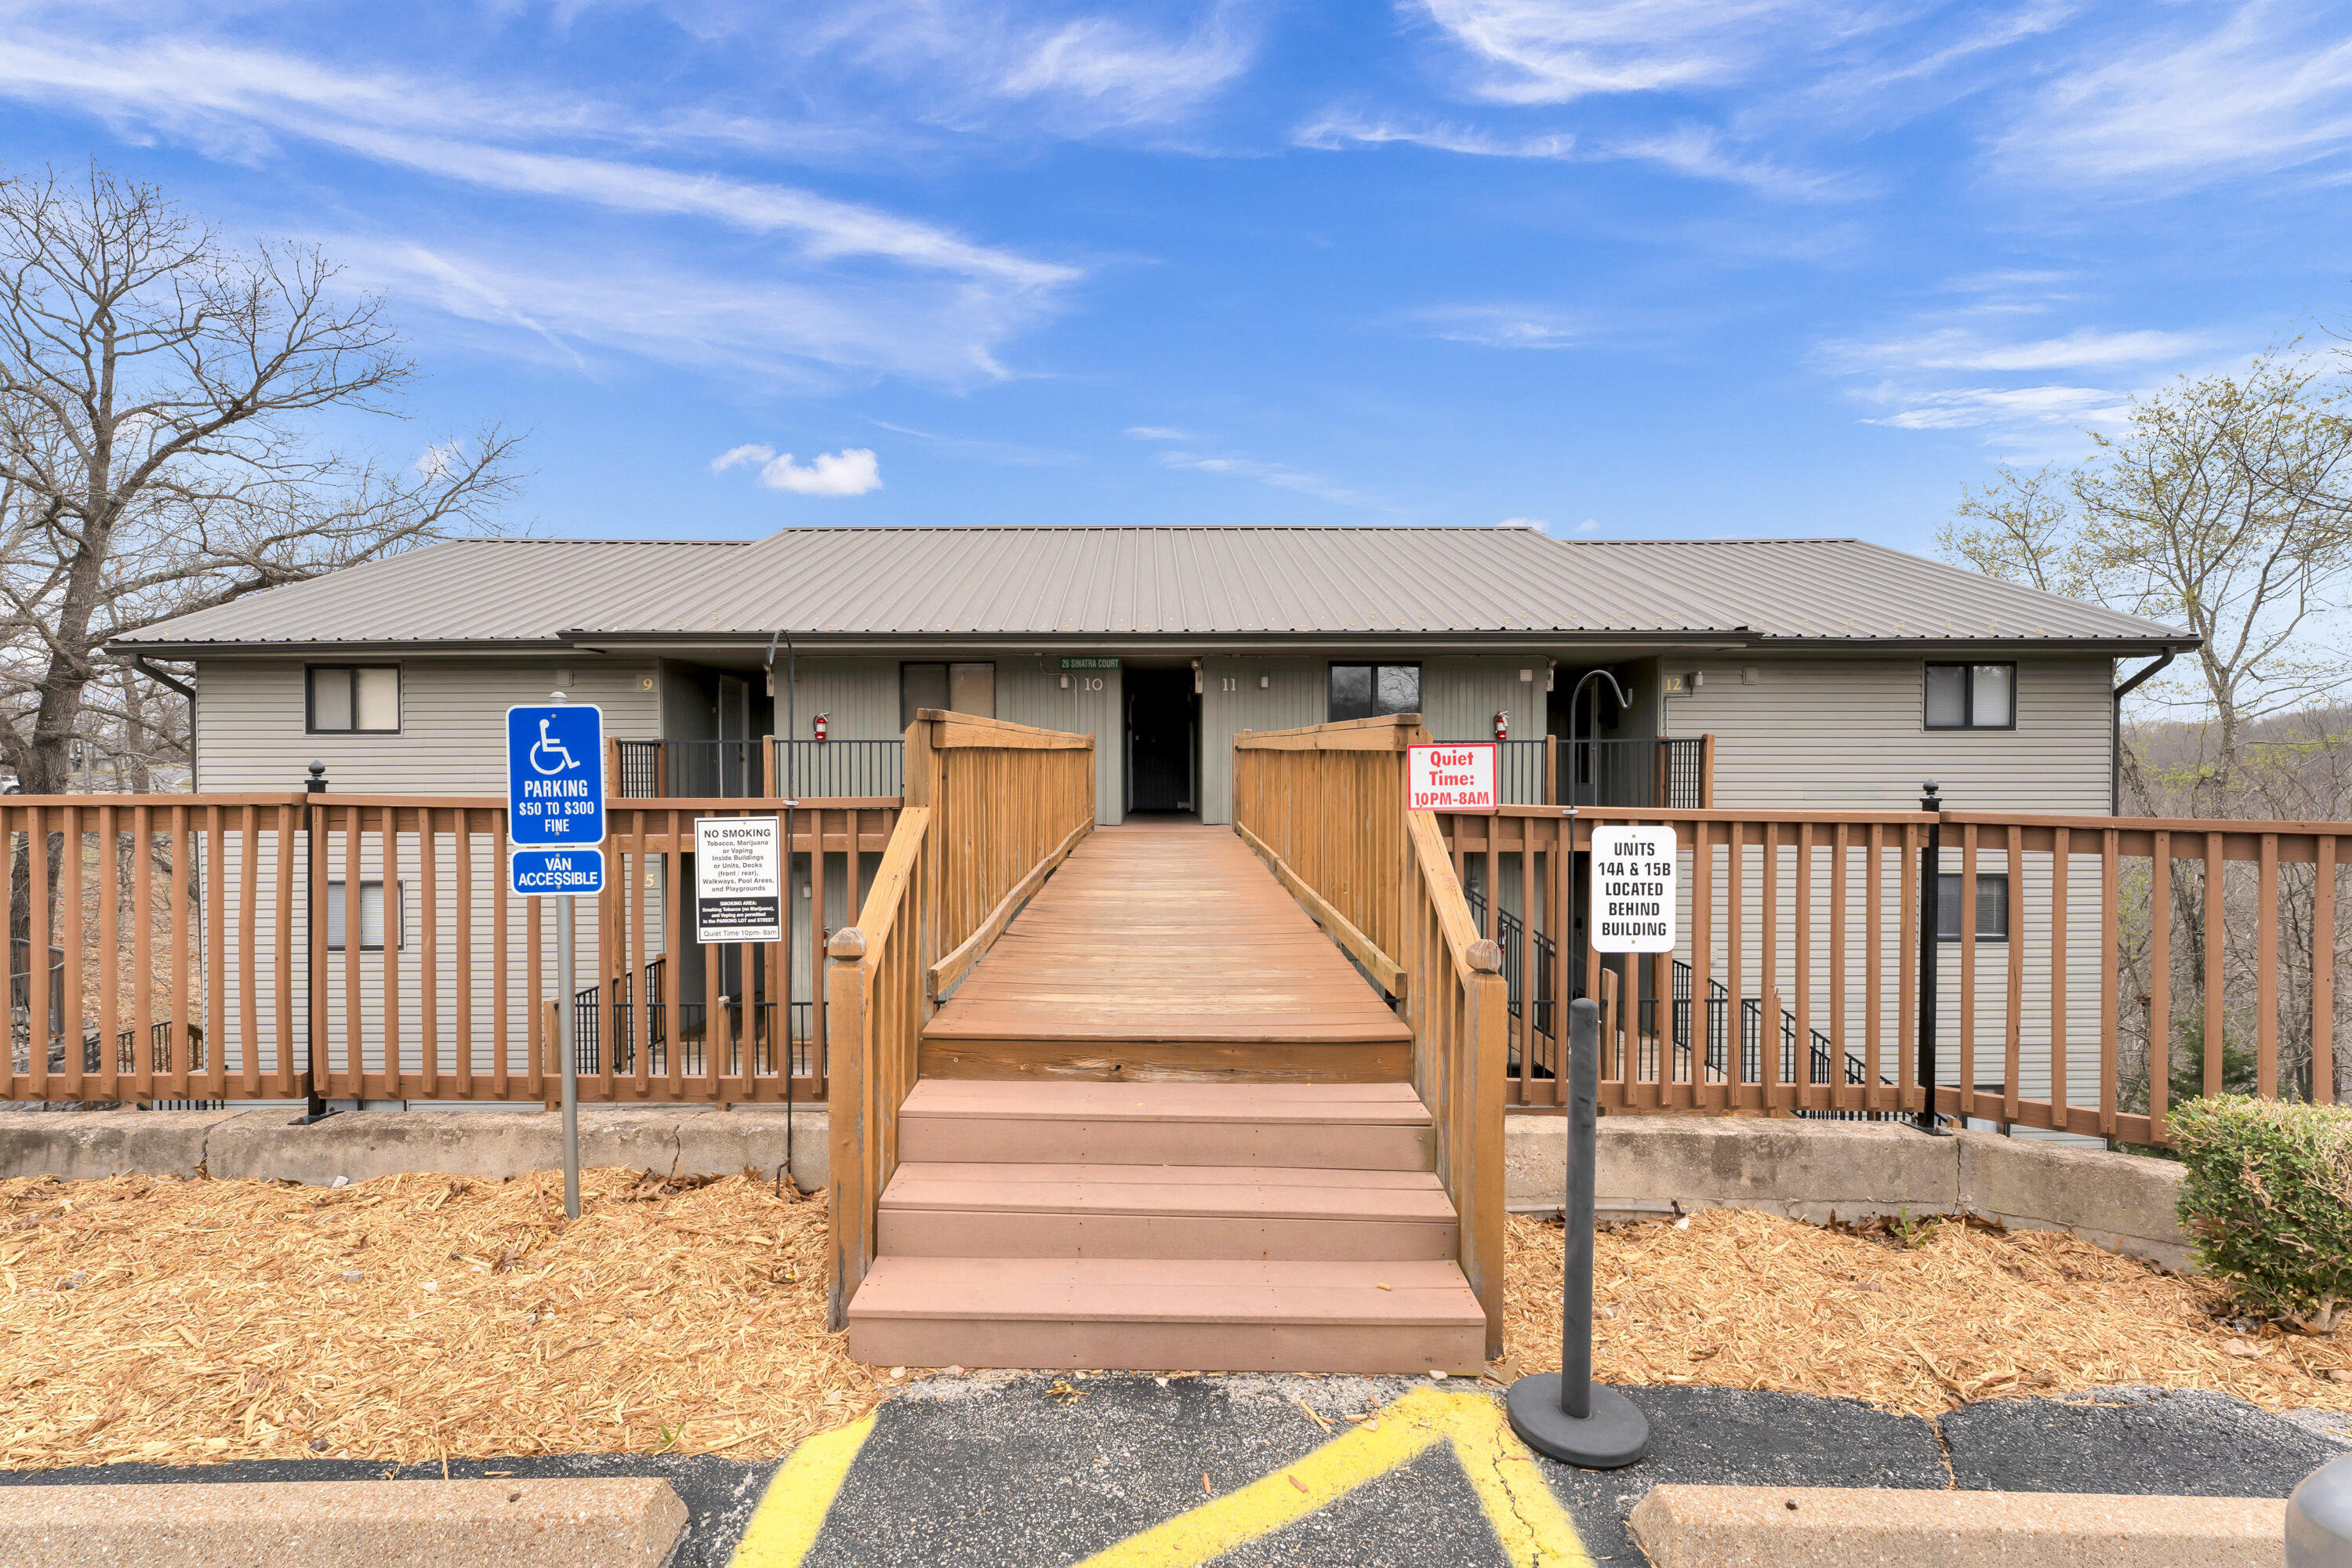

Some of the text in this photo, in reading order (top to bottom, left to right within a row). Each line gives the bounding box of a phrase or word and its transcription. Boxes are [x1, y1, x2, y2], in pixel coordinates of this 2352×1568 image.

[1062, 659, 1119, 668] 26 SINATRA COURT
[643, 678, 653, 690] 9
[1085, 677, 1103, 690] 10
[1222, 677, 1236, 691] 11
[1665, 678, 1682, 690] 12
[1430, 750, 1474, 768] Quiet
[1429, 770, 1474, 786] Time:
[524, 779, 588, 797] PARKING
[1415, 792, 1489, 805] 10PM-8AM
[519, 801, 594, 815] $50 TO $300
[545, 819, 569, 832] FINE
[722, 829, 771, 837] SMOKING
[1614, 843, 1655, 856] UNITS
[545, 858, 571, 870] VAN
[1598, 862, 1671, 876] 14A & 15B
[518, 872, 597, 886] ACCESSIBLE
[645, 873, 655, 887] 5
[1606, 882, 1663, 896] LOCATED
[1609, 902, 1660, 916] BEHIND
[1602, 923, 1667, 936] BUILDING
